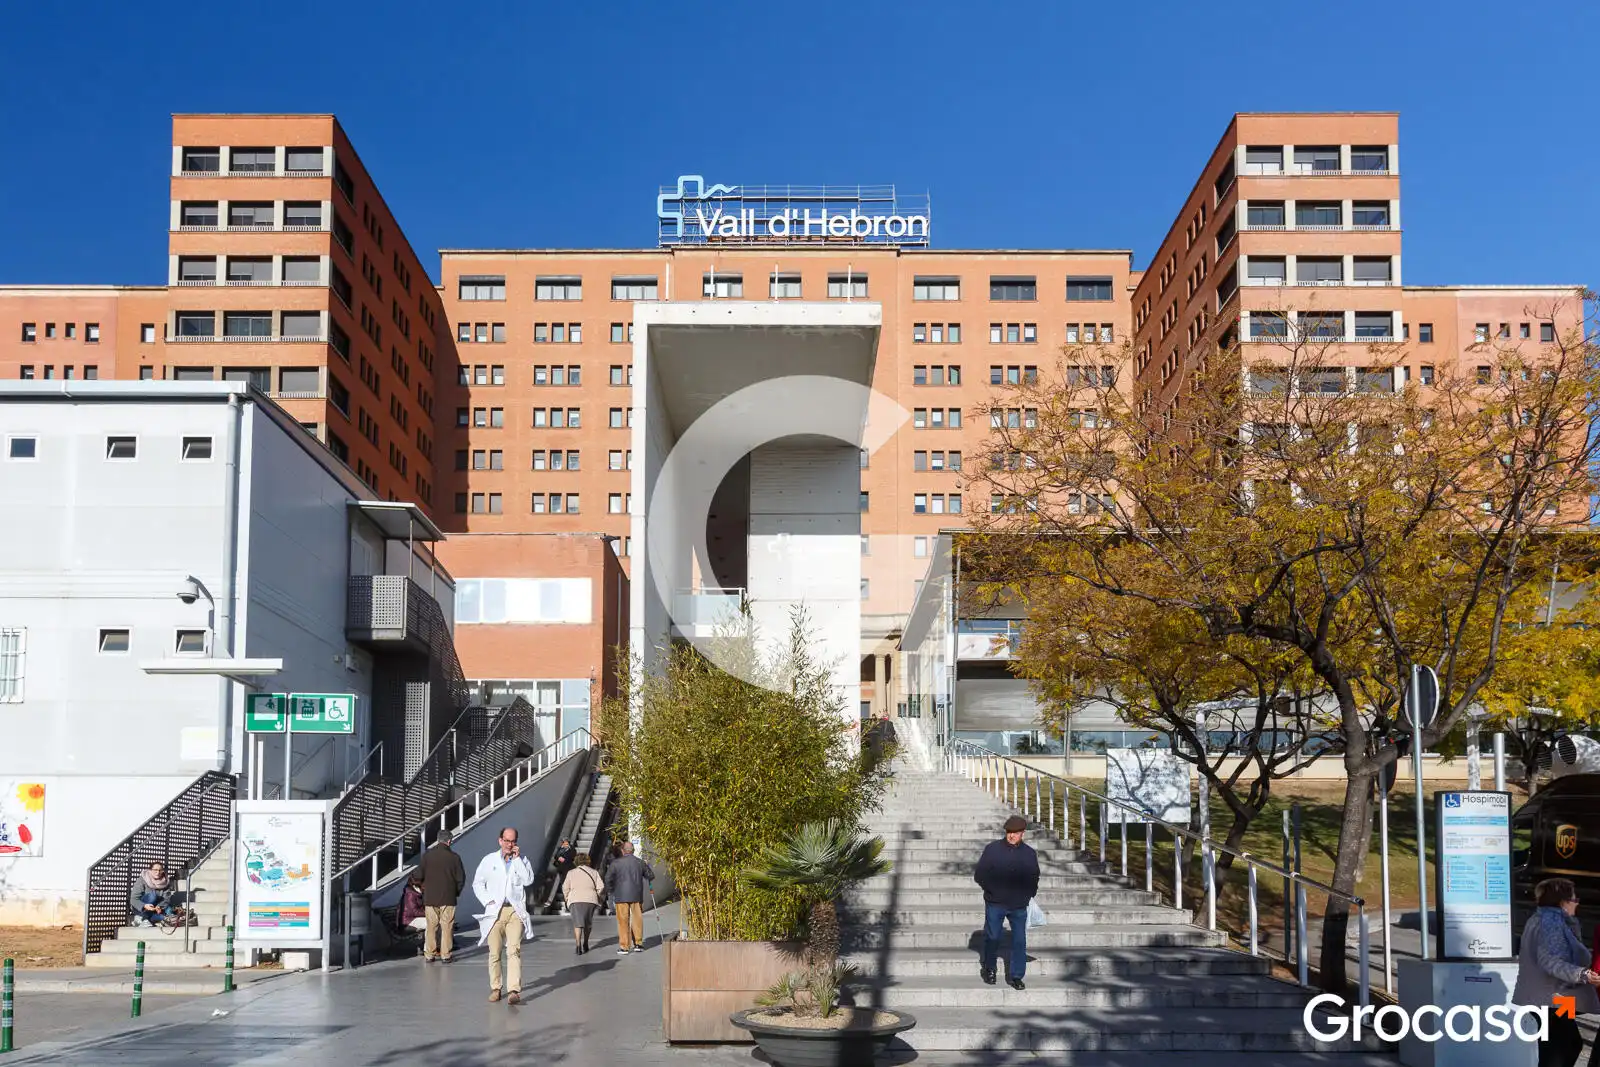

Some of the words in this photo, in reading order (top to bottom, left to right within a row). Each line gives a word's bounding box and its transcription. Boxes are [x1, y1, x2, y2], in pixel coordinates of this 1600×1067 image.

[696, 208, 755, 236] Vall
[768, 208, 928, 237] d'Hebron
[1557, 834, 1575, 852] ups
